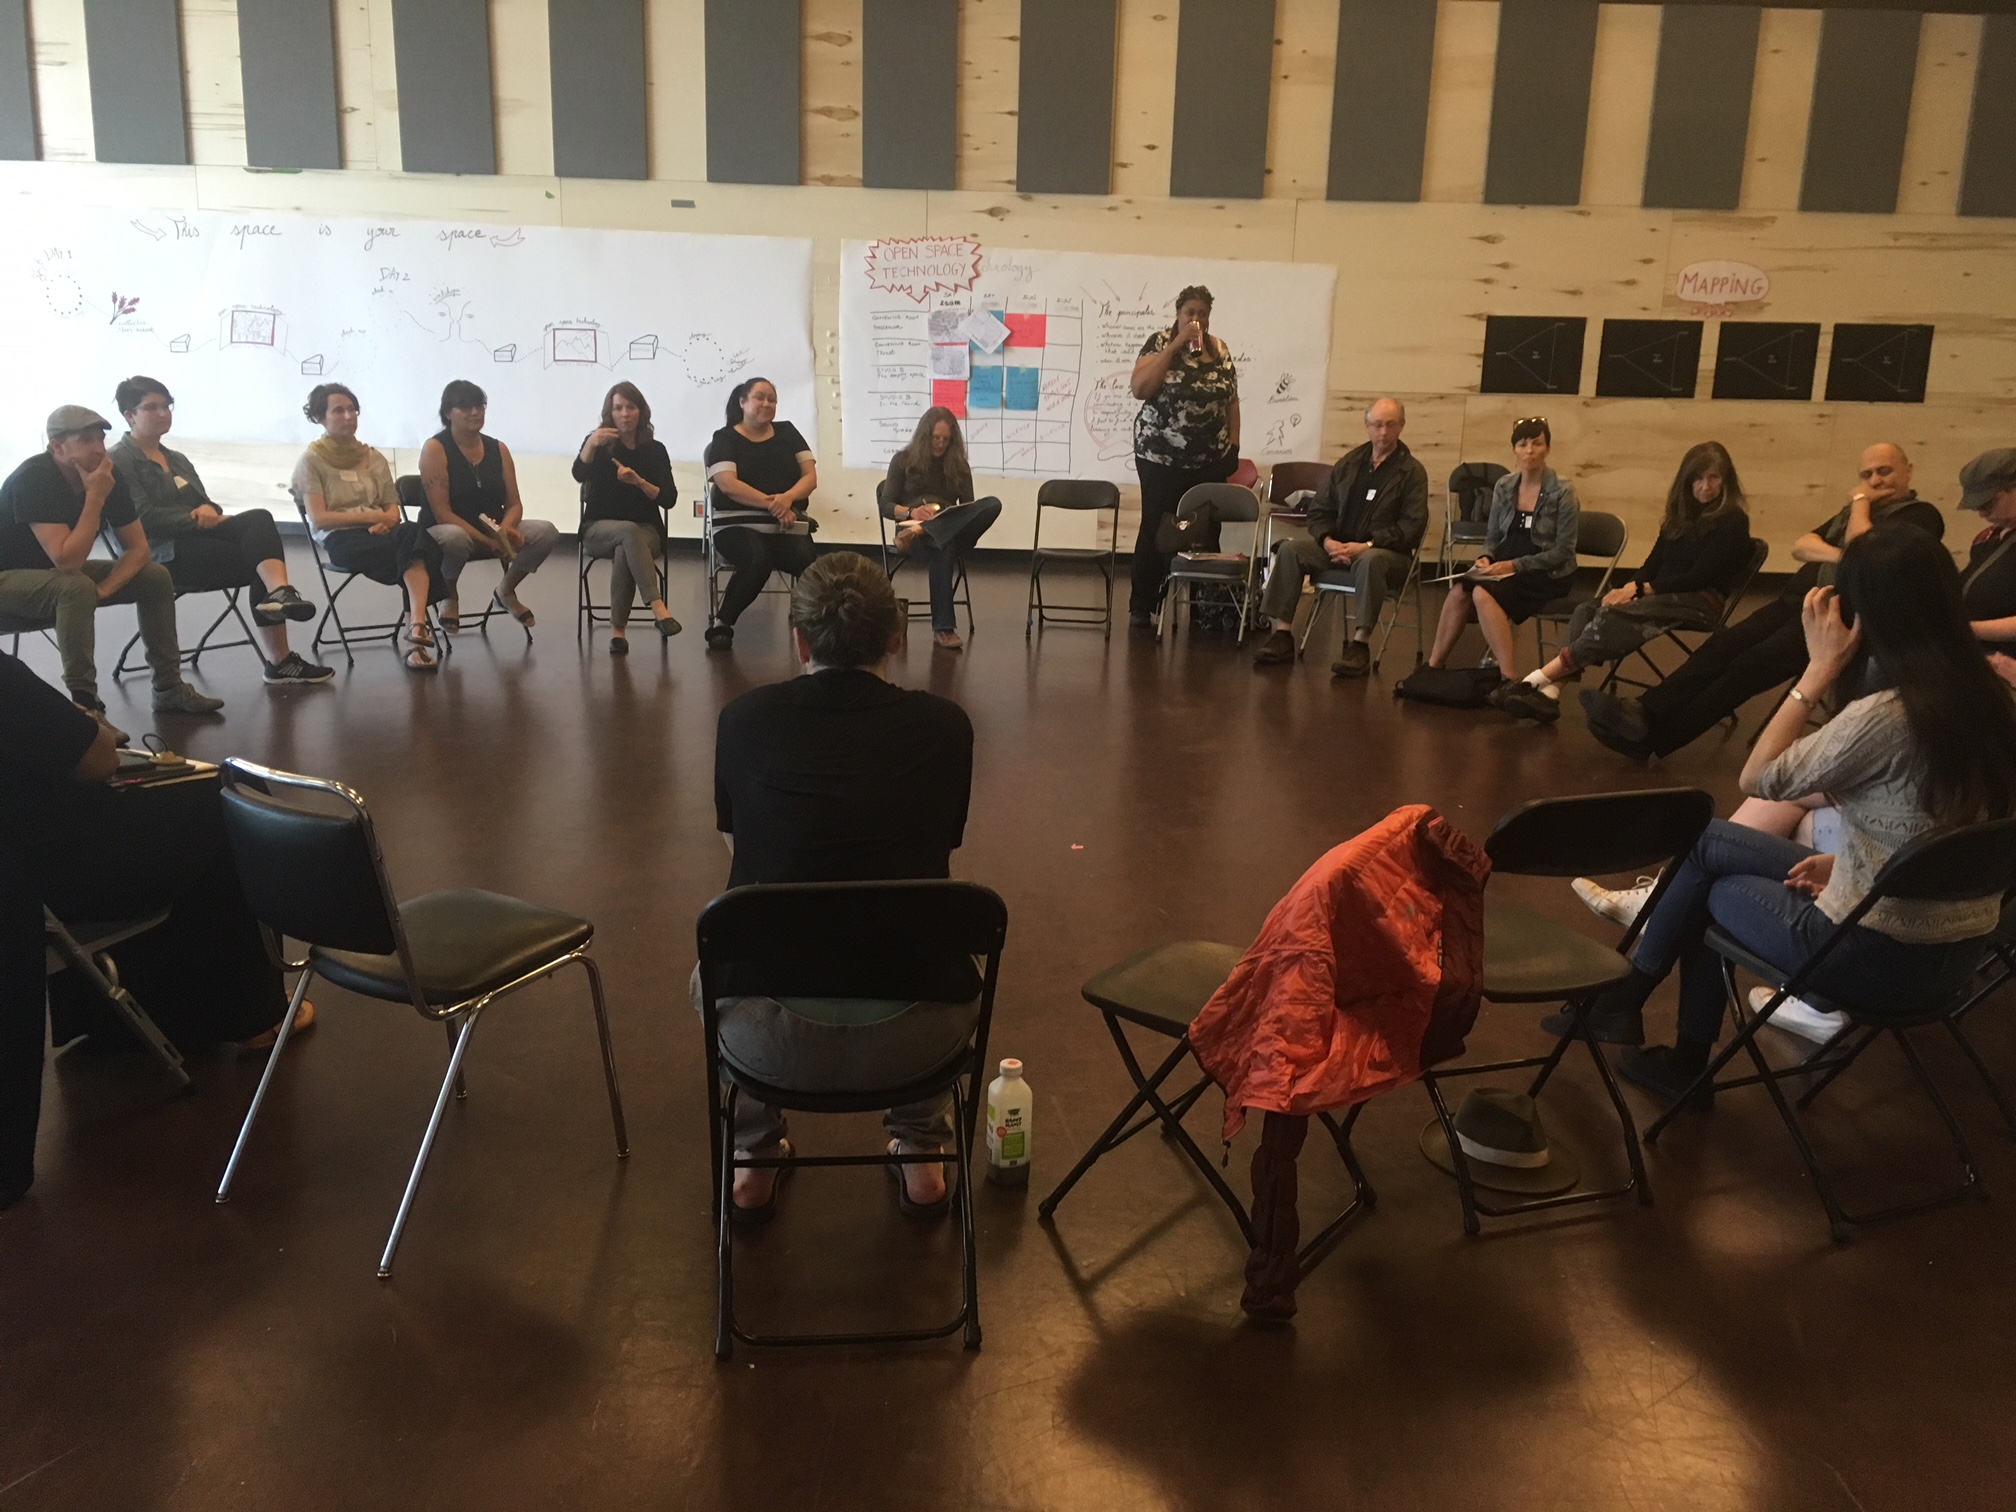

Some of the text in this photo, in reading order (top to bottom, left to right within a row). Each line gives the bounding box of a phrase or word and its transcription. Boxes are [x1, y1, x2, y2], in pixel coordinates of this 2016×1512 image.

[165, 215, 487, 252] This space is your space
[44, 247, 64, 262] DAY
[884, 242, 964, 263] OPEN SPACE
[380, 266, 412, 282] DAY 2
[883, 262, 967, 280] TECHNOLOGY
[1098, 300, 1113, 319] The
[1093, 377, 1107, 391] The
